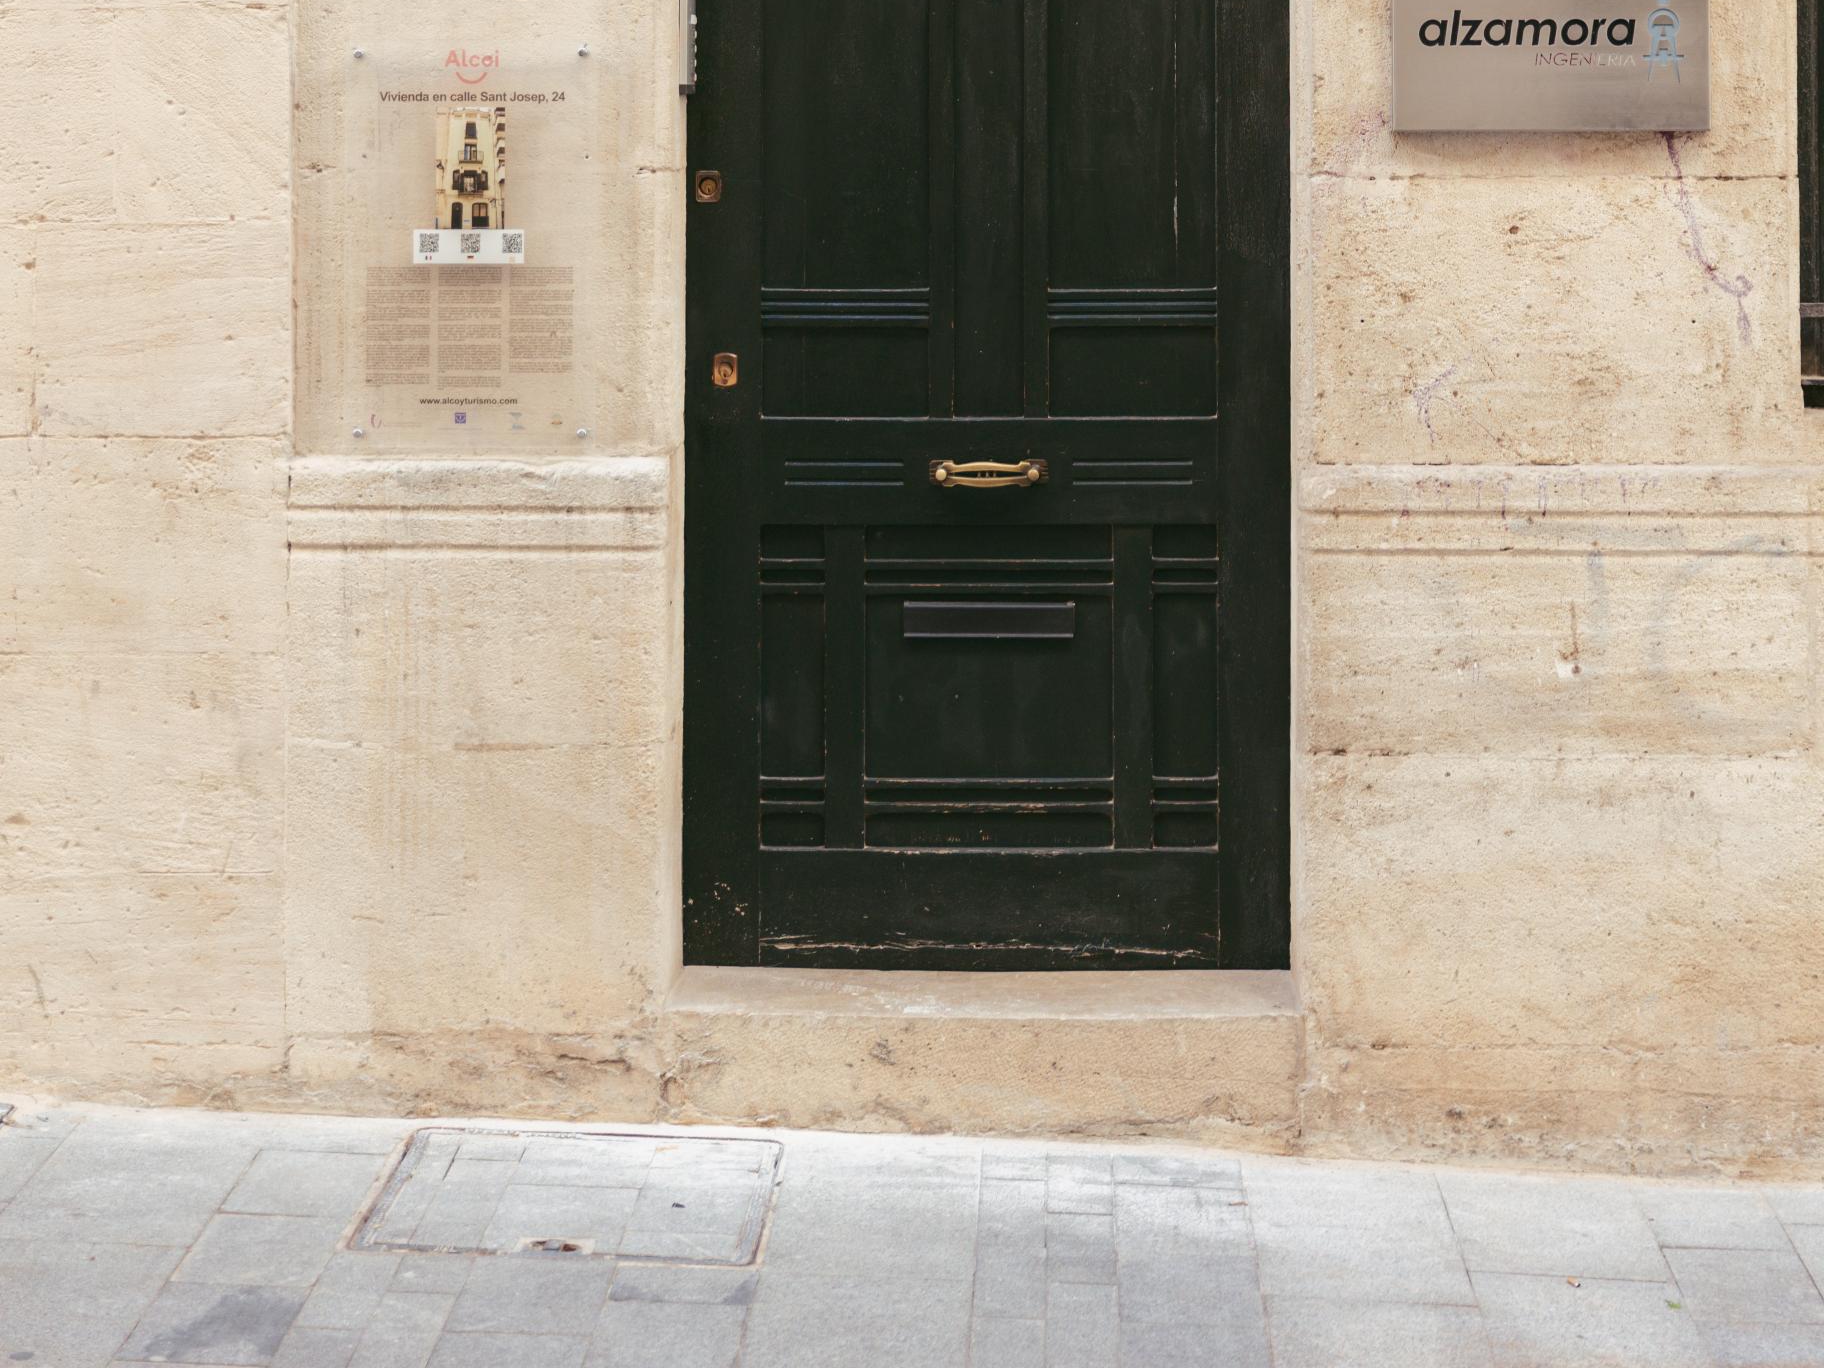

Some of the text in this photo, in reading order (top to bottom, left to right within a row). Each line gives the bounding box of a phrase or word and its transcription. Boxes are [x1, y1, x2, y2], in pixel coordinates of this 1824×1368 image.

[1418, 9, 1637, 47] alzamora
[444, 49, 500, 68] Alcoi
[379, 91, 566, 105] Vivienda en calle Sant Josep, 24
[419, 397, 519, 407] www.alcoyturismo.com
